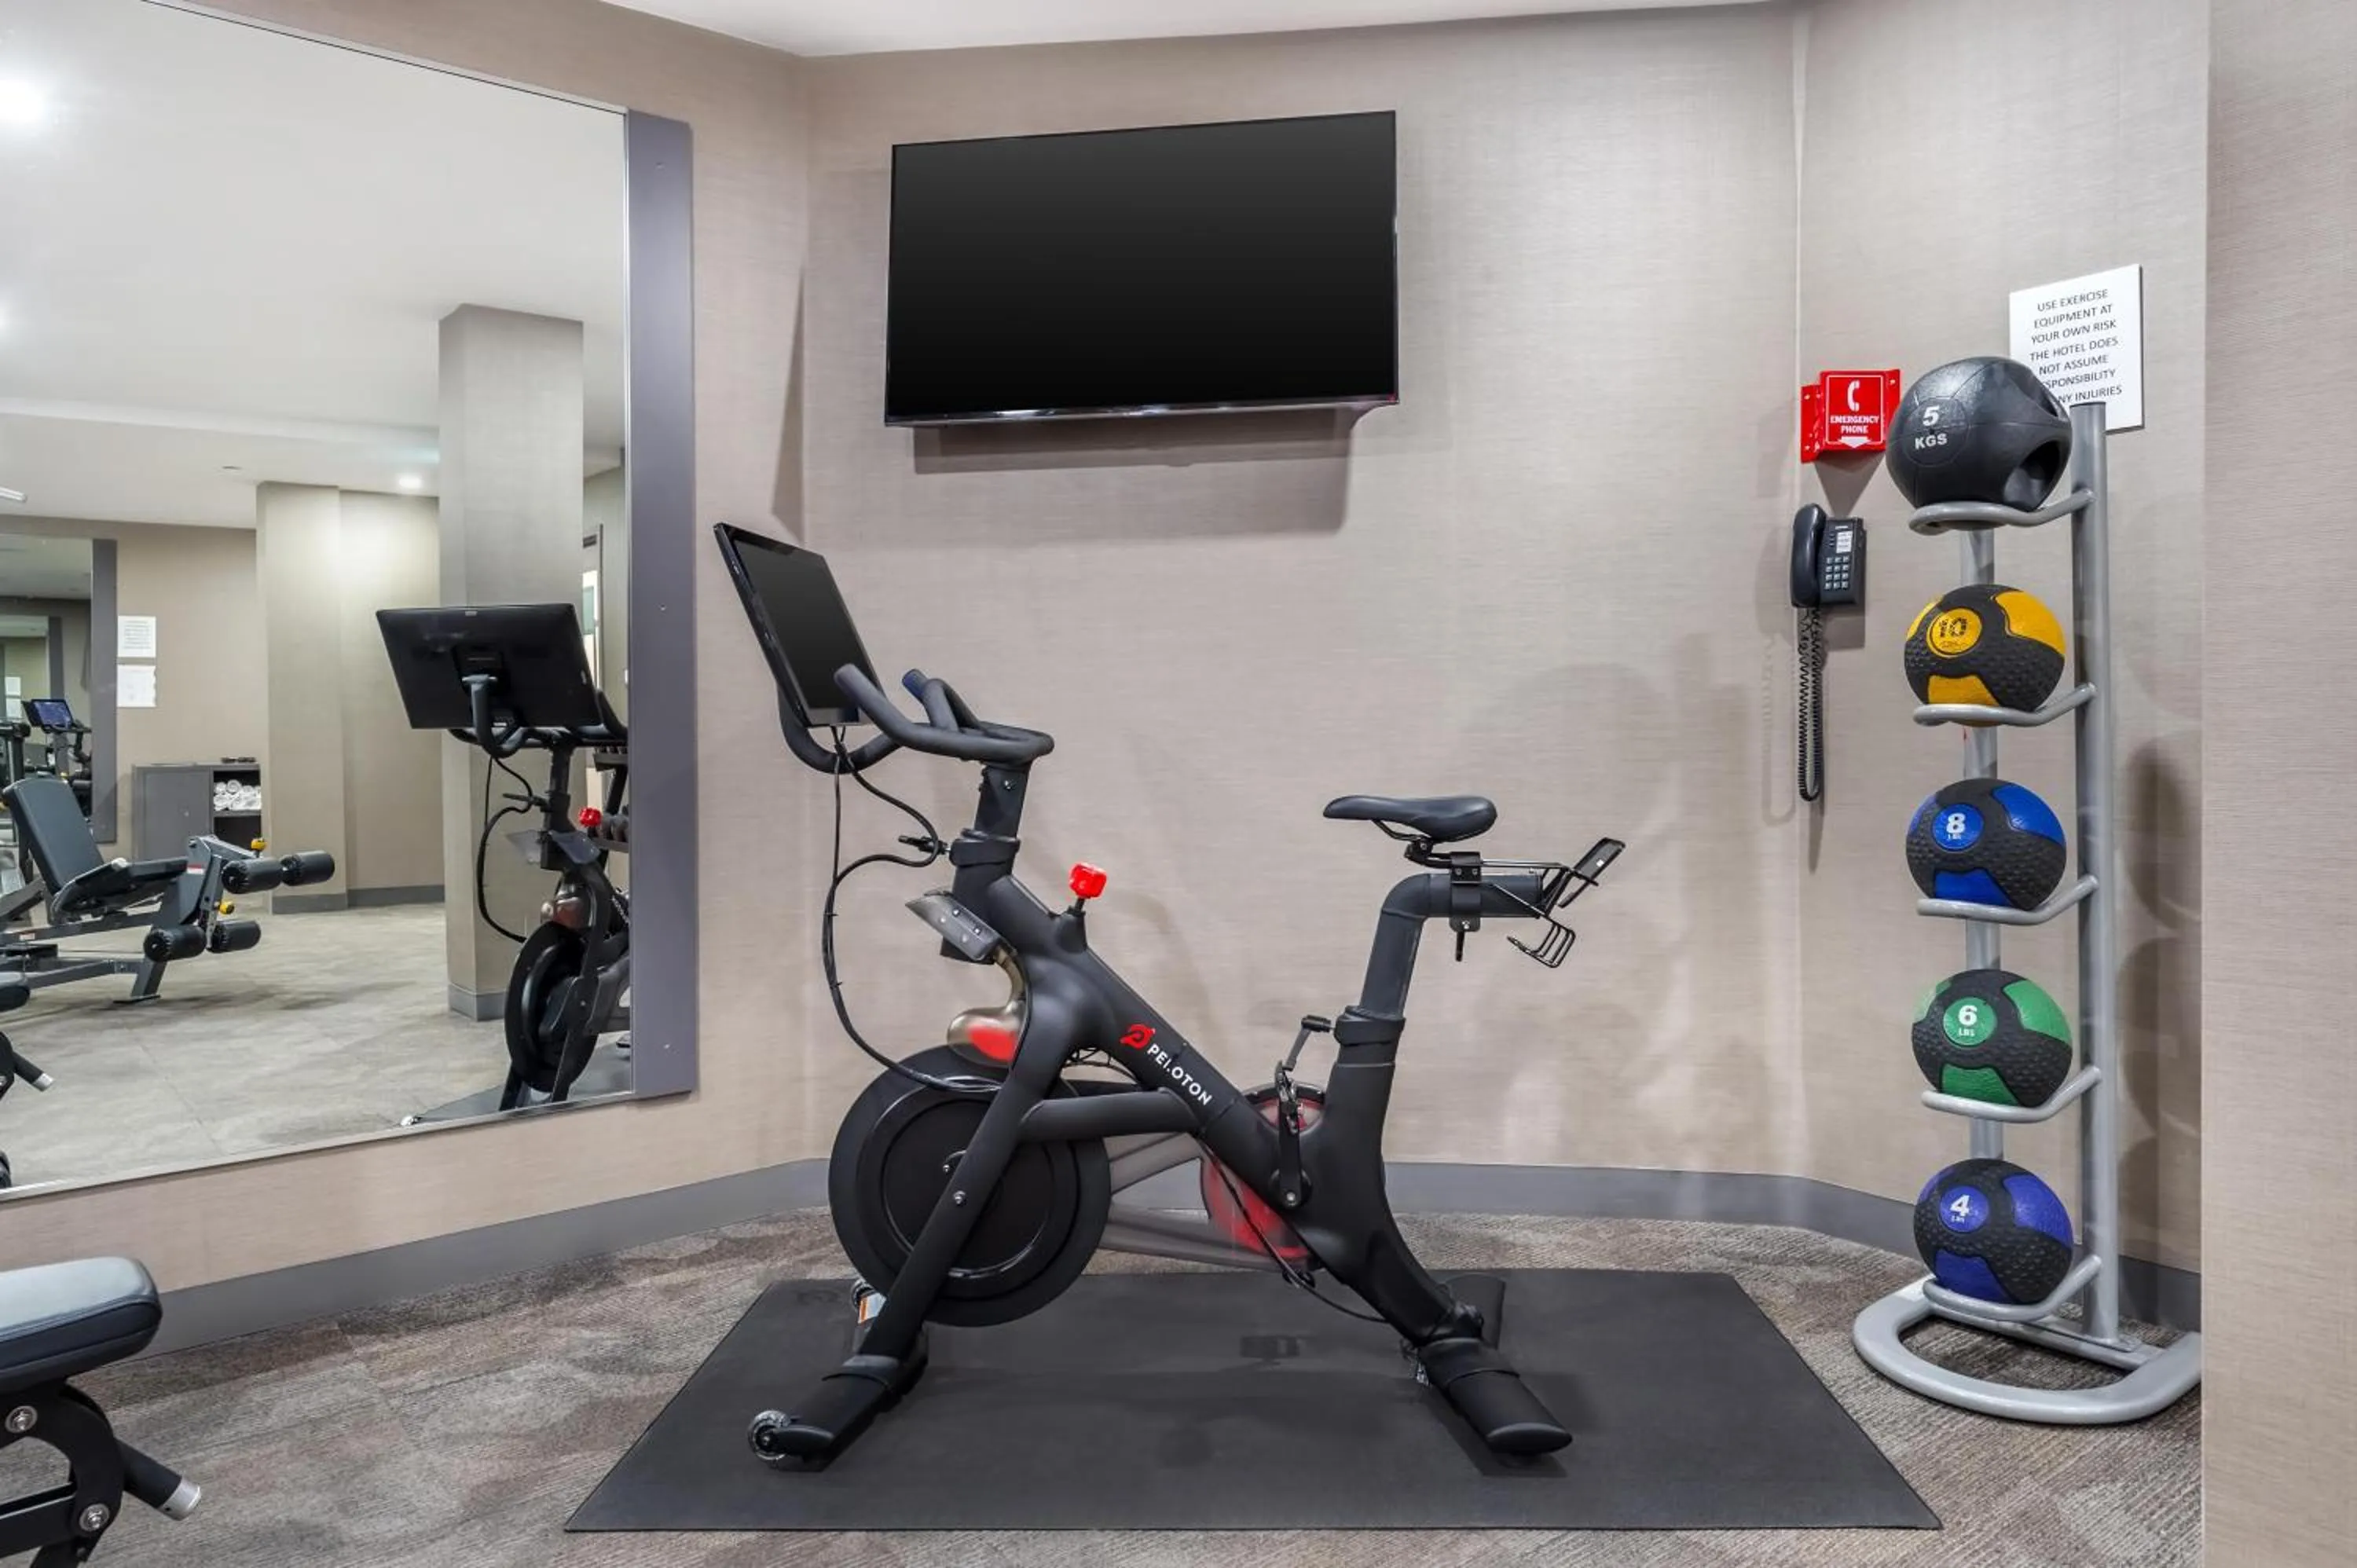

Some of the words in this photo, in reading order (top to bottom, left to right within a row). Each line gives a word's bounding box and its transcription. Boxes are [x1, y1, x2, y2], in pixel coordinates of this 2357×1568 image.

[2037, 300, 2058, 312] USE
[2060, 289, 2109, 307] EXERCISE
[2034, 307, 2097, 329] EQUIPMENT
[2100, 303, 2113, 315] AT
[2032, 331, 2059, 345] YOUR
[2062, 325, 2091, 339] OWN
[2093, 319, 2117, 332] RISK
[2030, 350, 2049, 361] THE
[2053, 343, 2086, 357] HOTEL
[2089, 336, 2119, 350] DOES
[2039, 363, 2060, 376] NOT
[2064, 355, 2109, 370] ASSUME
[2044, 368, 2116, 389] SPONSIBILITY
[2058, 394, 2072, 403] NY
[2075, 385, 2122, 401] INJURIES
[1830, 415, 1880, 423] EMERGENCY
[1923, 405, 1941, 427] 5
[1841, 425, 1869, 434] PHONE
[1915, 432, 1948, 450] KGS
[1940, 617, 1967, 638] 10
[1946, 812, 1967, 833] 8
[1958, 1005, 1978, 1025] 6
[1147, 1043, 1212, 1105] PELOTON
[1949, 1194, 1970, 1217] 4
